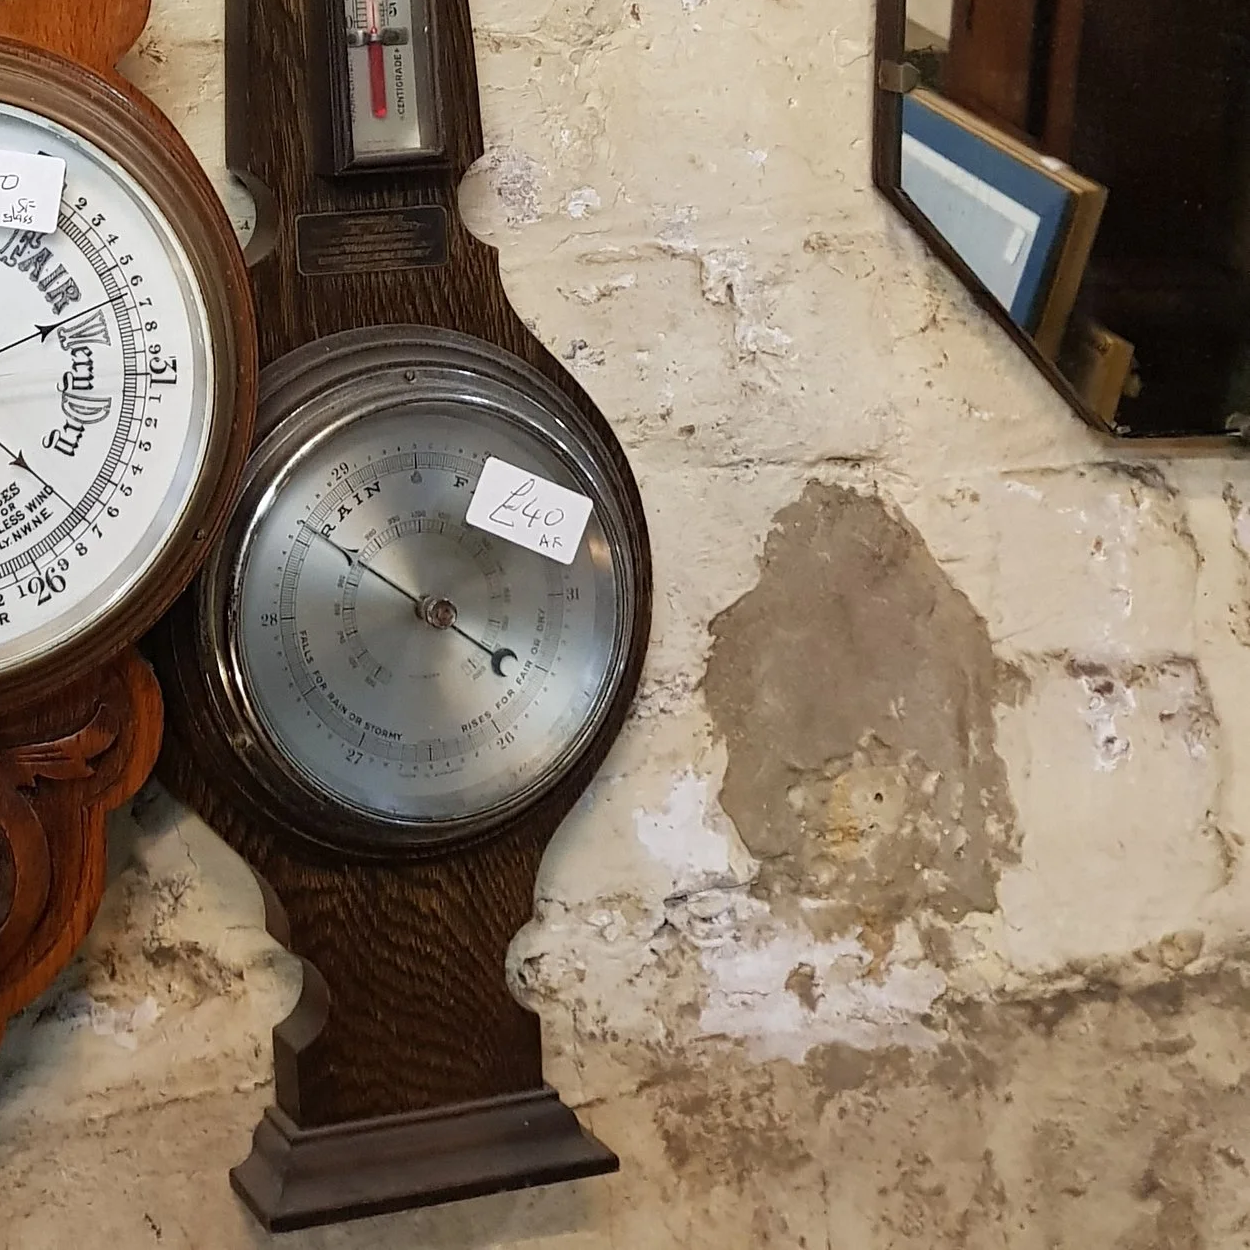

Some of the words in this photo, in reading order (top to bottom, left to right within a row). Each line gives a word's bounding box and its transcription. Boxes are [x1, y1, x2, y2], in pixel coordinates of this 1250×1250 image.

[74, 197, 88, 212] 2
[91, 213, 107, 227] 3
[106, 232, 120, 247] 4
[119, 253, 134, 267] 5
[130, 274, 144, 287] 6
[138, 296, 153, 310] 7
[144, 320, 158, 333] 8
[149, 355, 178, 388] 31
[148, 392, 162, 404] 1
[144, 416, 158, 429] 2
[138, 439, 152, 452] 3
[131, 463, 144, 477] 4
[331, 461, 350, 481] 29
[119, 483, 133, 497] 5
[25, 483, 54, 514] WIND
[488, 478, 565, 528] £40
[106, 505, 120, 518] 6
[320, 480, 381, 539] RAIN
[91, 524, 104, 539] 7
[75, 542, 89, 557] 8
[57, 558, 70, 571] 9
[16, 584, 28, 599] 1
[27, 567, 67, 606] 26
[566, 587, 580, 600] 31
[261, 613, 278, 627] 28
[460, 710, 492, 733] RISES
[495, 688, 516, 710] FOR
[515, 660, 533, 685] FAIR
[531, 637, 541, 655] OR
[536, 607, 547, 632] DRY
[299, 629, 315, 665] FALLS
[312, 669, 328, 691] FOR
[327, 691, 348, 715] RAIN
[348, 711, 363, 726] OR
[363, 721, 403, 741] STORMY
[496, 731, 515, 750] 26
[345, 749, 364, 765] 27
